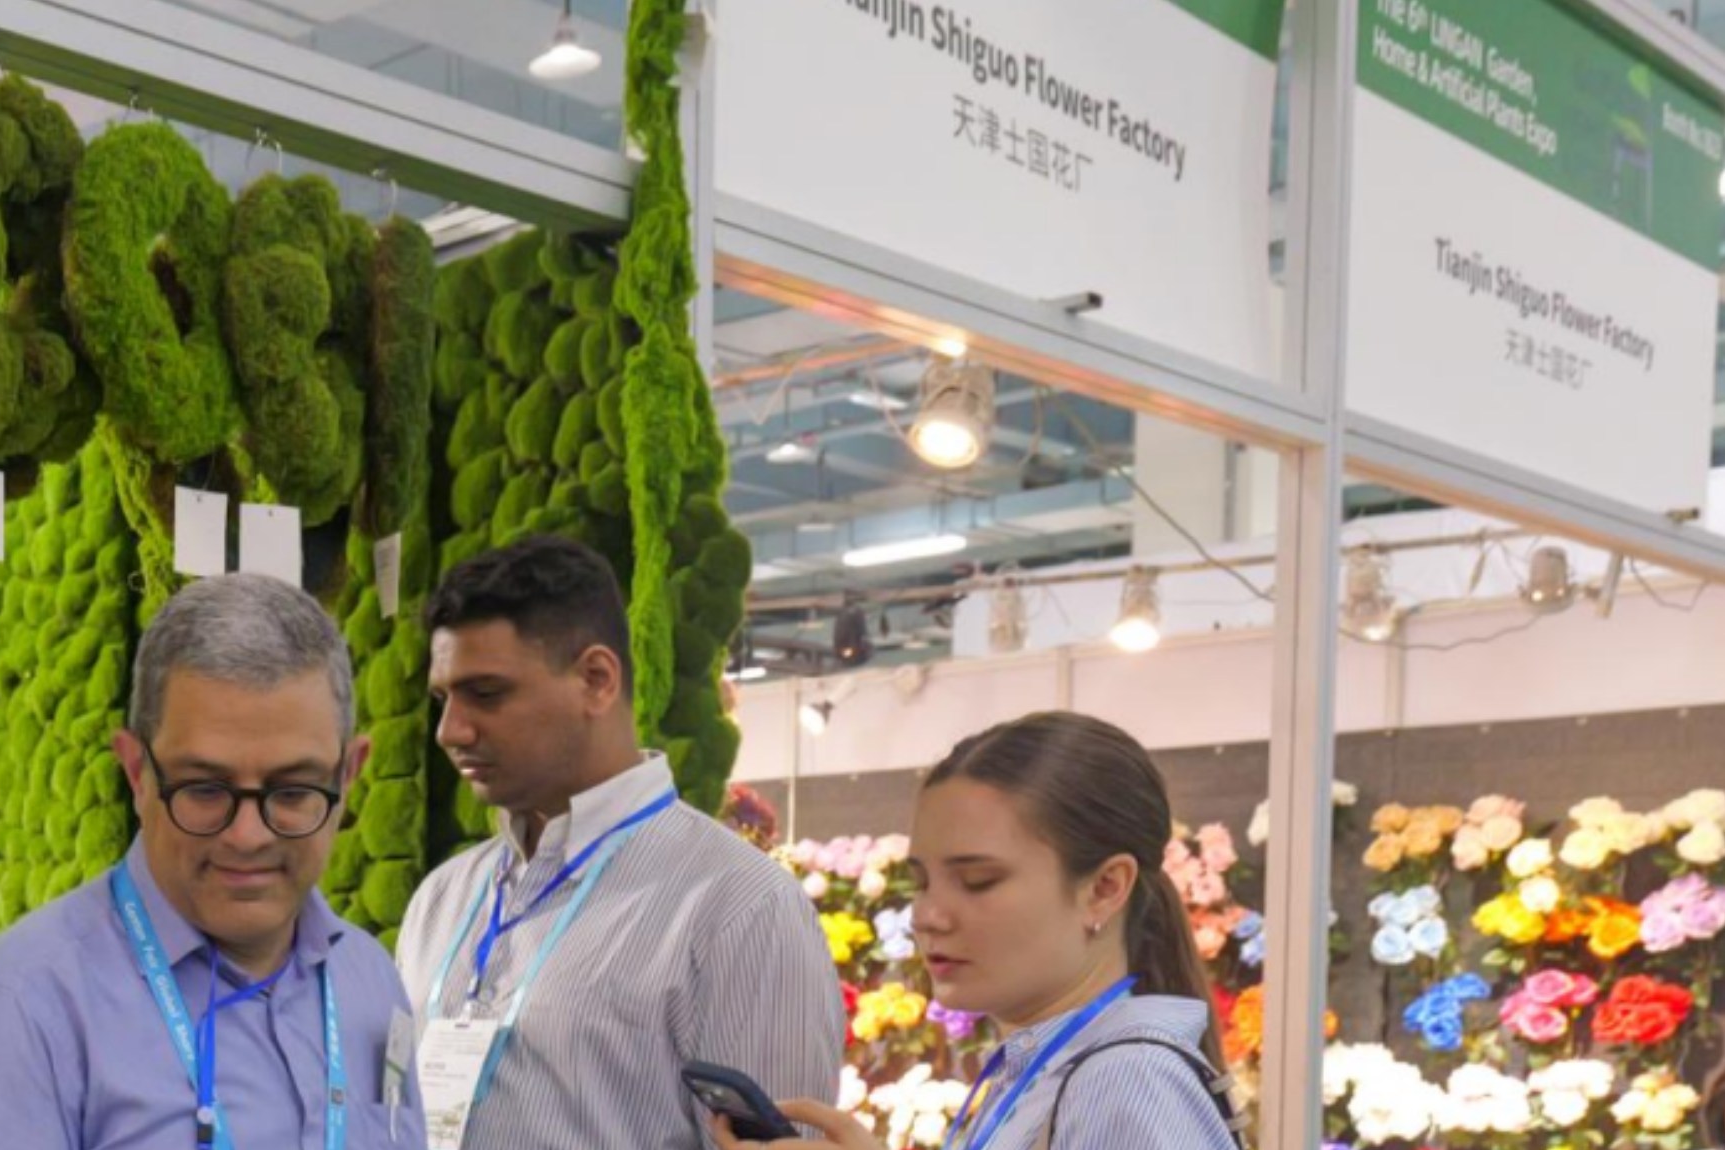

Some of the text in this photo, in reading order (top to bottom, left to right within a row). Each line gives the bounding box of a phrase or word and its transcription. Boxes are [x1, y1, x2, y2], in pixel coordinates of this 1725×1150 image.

[931, 6, 1019, 84] Shiguo
[1024, 54, 1104, 131] Flower
[1106, 98, 1186, 181] Factory
[1372, 25, 1417, 78] Home
[1429, 59, 1485, 117] Artificial
[1486, 90, 1526, 138] Plants
[1526, 111, 1558, 156] Expo
[1430, 10, 1483, 71] LINGAN
[951, 93, 1093, 192] 天津士国花厂
[1434, 236, 1655, 372] Tianjin Shiguo Flower Factory
